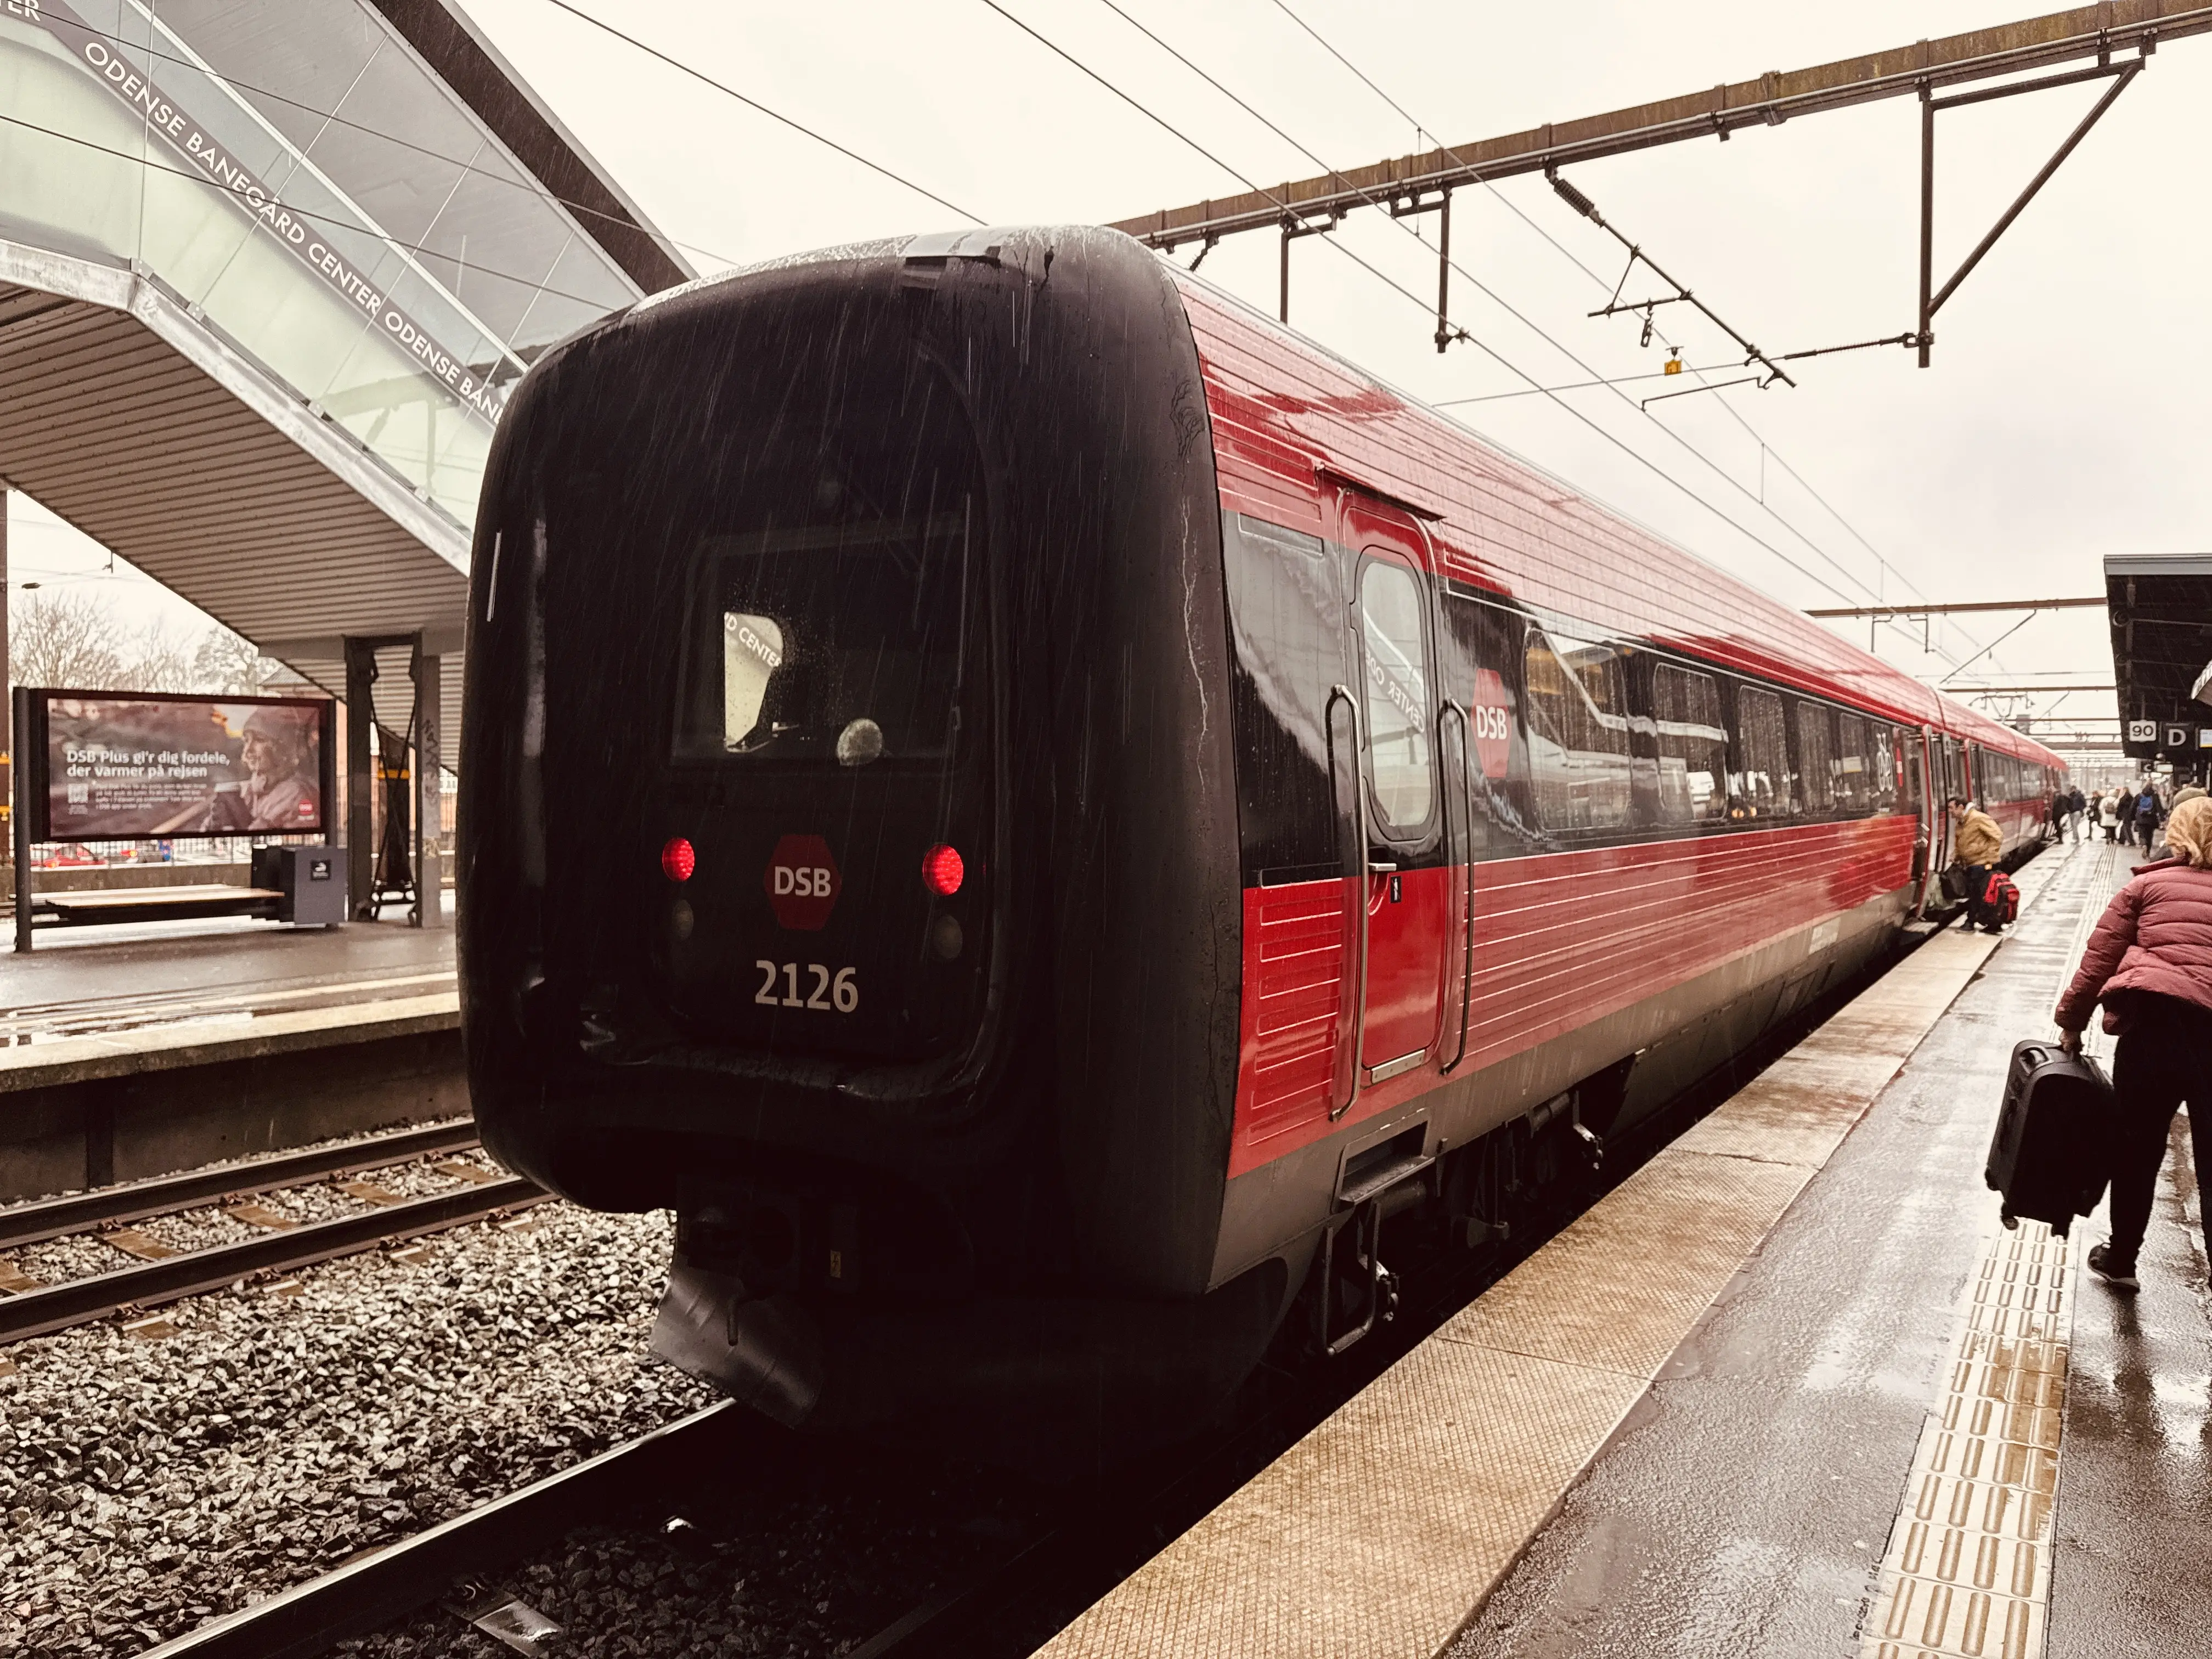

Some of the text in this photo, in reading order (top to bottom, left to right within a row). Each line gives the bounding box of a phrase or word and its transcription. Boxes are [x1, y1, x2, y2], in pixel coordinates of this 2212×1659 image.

[85, 42, 186, 137] ODENSE
[185, 132, 305, 244] BANEGÅRD
[308, 242, 382, 315] CENTER
[385, 311, 461, 385] ODENSE
[1476, 705, 1507, 740] DSB
[2132, 725, 2153, 736] 90
[2168, 729, 2186, 746] D
[66, 751, 96, 763] DSB
[100, 751, 129, 764] Plus
[157, 751, 178, 765] dig
[182, 751, 230, 766] fordele,
[66, 764, 207, 780] der varmer på rejsen
[774, 866, 832, 897] DSB
[754, 959, 859, 1013] 2126
